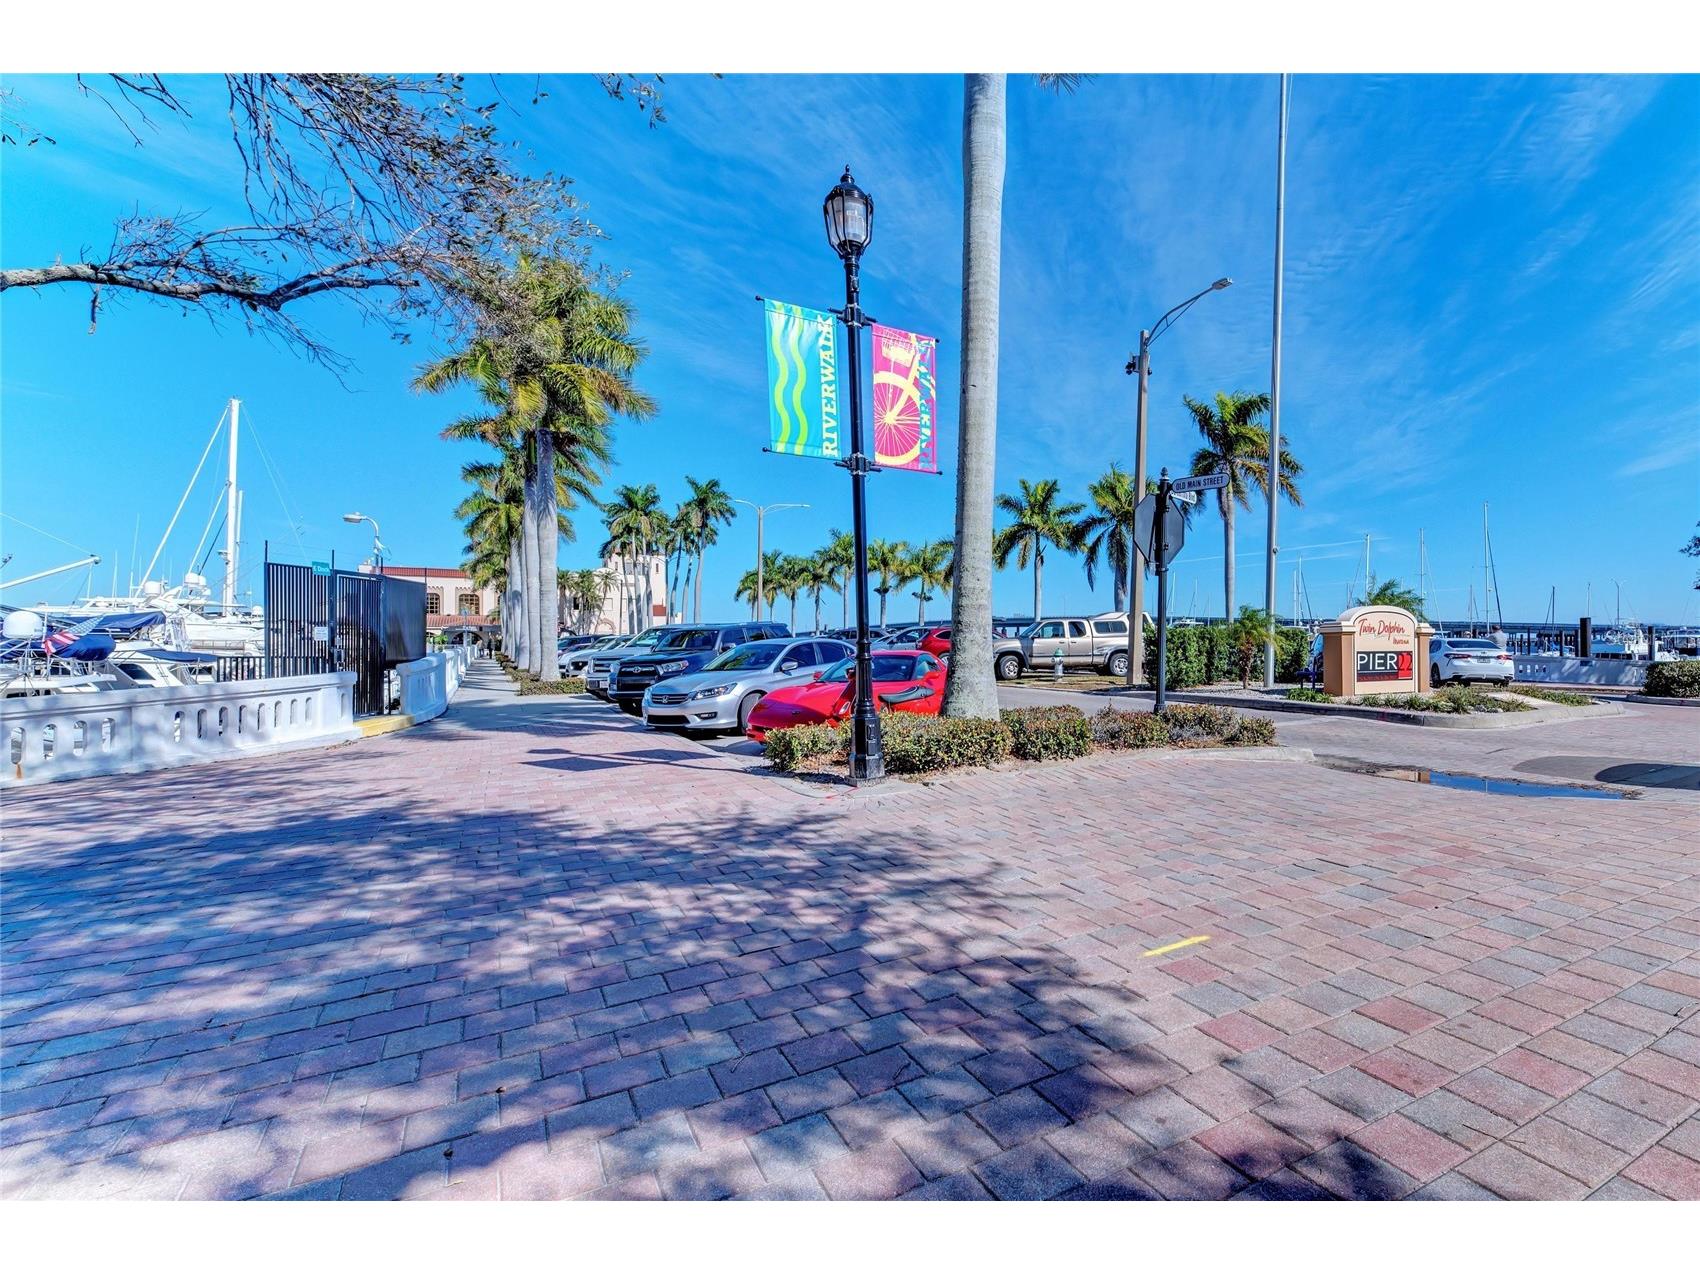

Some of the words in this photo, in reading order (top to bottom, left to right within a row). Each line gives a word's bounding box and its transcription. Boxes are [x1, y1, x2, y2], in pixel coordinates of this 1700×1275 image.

[817, 315, 837, 458] RIVERWALK
[1175, 482, 1186, 490] OLD
[1187, 480, 1201, 488] MAIN
[1202, 476, 1223, 486] STREET
[1358, 618, 1375, 636] Twin
[1377, 620, 1405, 640] Dolphin
